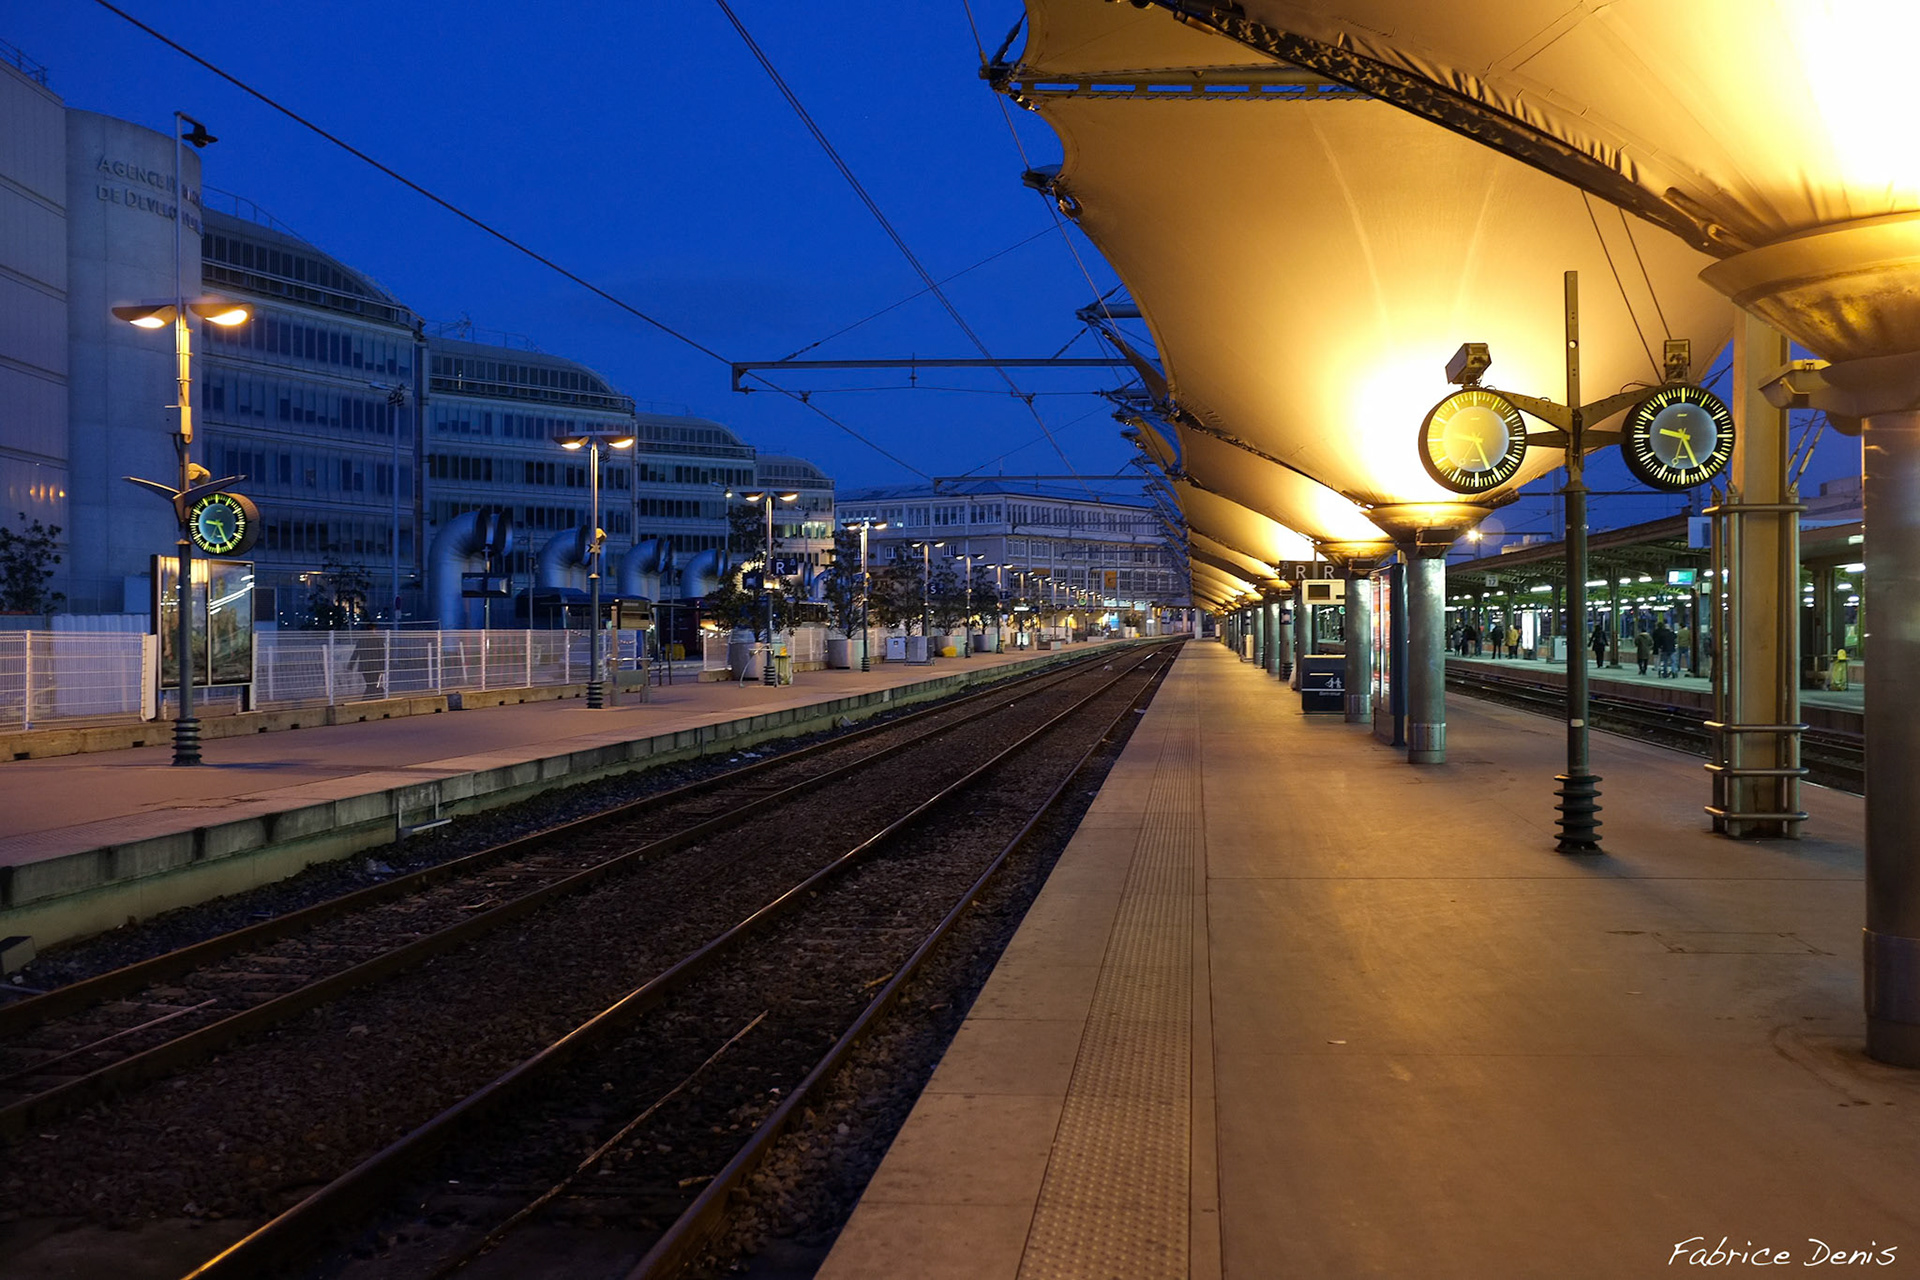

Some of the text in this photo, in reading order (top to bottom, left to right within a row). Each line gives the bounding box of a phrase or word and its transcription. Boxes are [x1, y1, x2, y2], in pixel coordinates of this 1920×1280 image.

[97, 155, 164, 189] AGENCE
[96, 185, 120, 201] DE
[776, 562, 786, 575] R
[1295, 564, 1335, 579] R R
[930, 585, 937, 595] S
[1524, 585, 1530, 594] S
